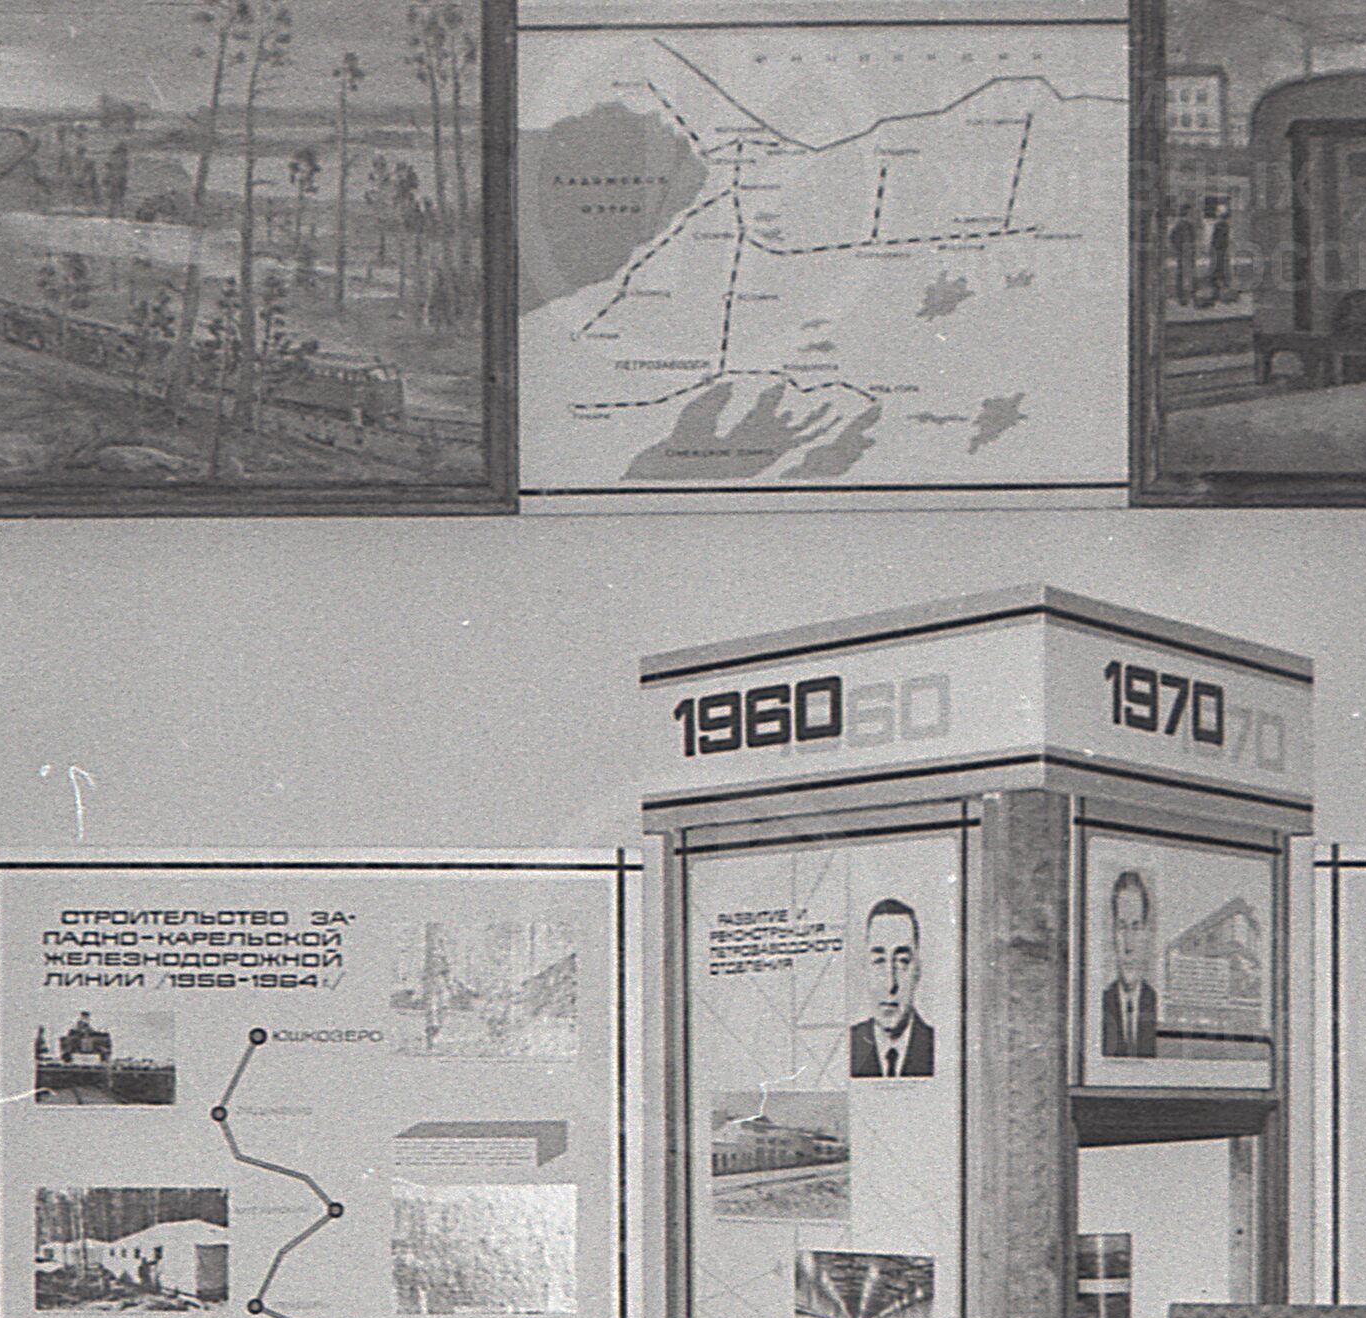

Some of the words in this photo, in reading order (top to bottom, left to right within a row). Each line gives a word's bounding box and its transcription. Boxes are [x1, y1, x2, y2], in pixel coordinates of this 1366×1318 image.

[1103, 660, 1225, 747] 1970
[673, 675, 843, 757] 1960
[60, 910, 289, 926] СТРОИТЕЛЬСТВО
[43, 928, 342, 947] ПАДНО-КАРЕЛЬСКОЙ
[43, 949, 343, 968] ЖЕЛЕЗНОДОРОЖНОЙ
[43, 973, 145, 987] ЛИНИИ
[272, 1030, 384, 1043] ЮШКОЗЕРО
